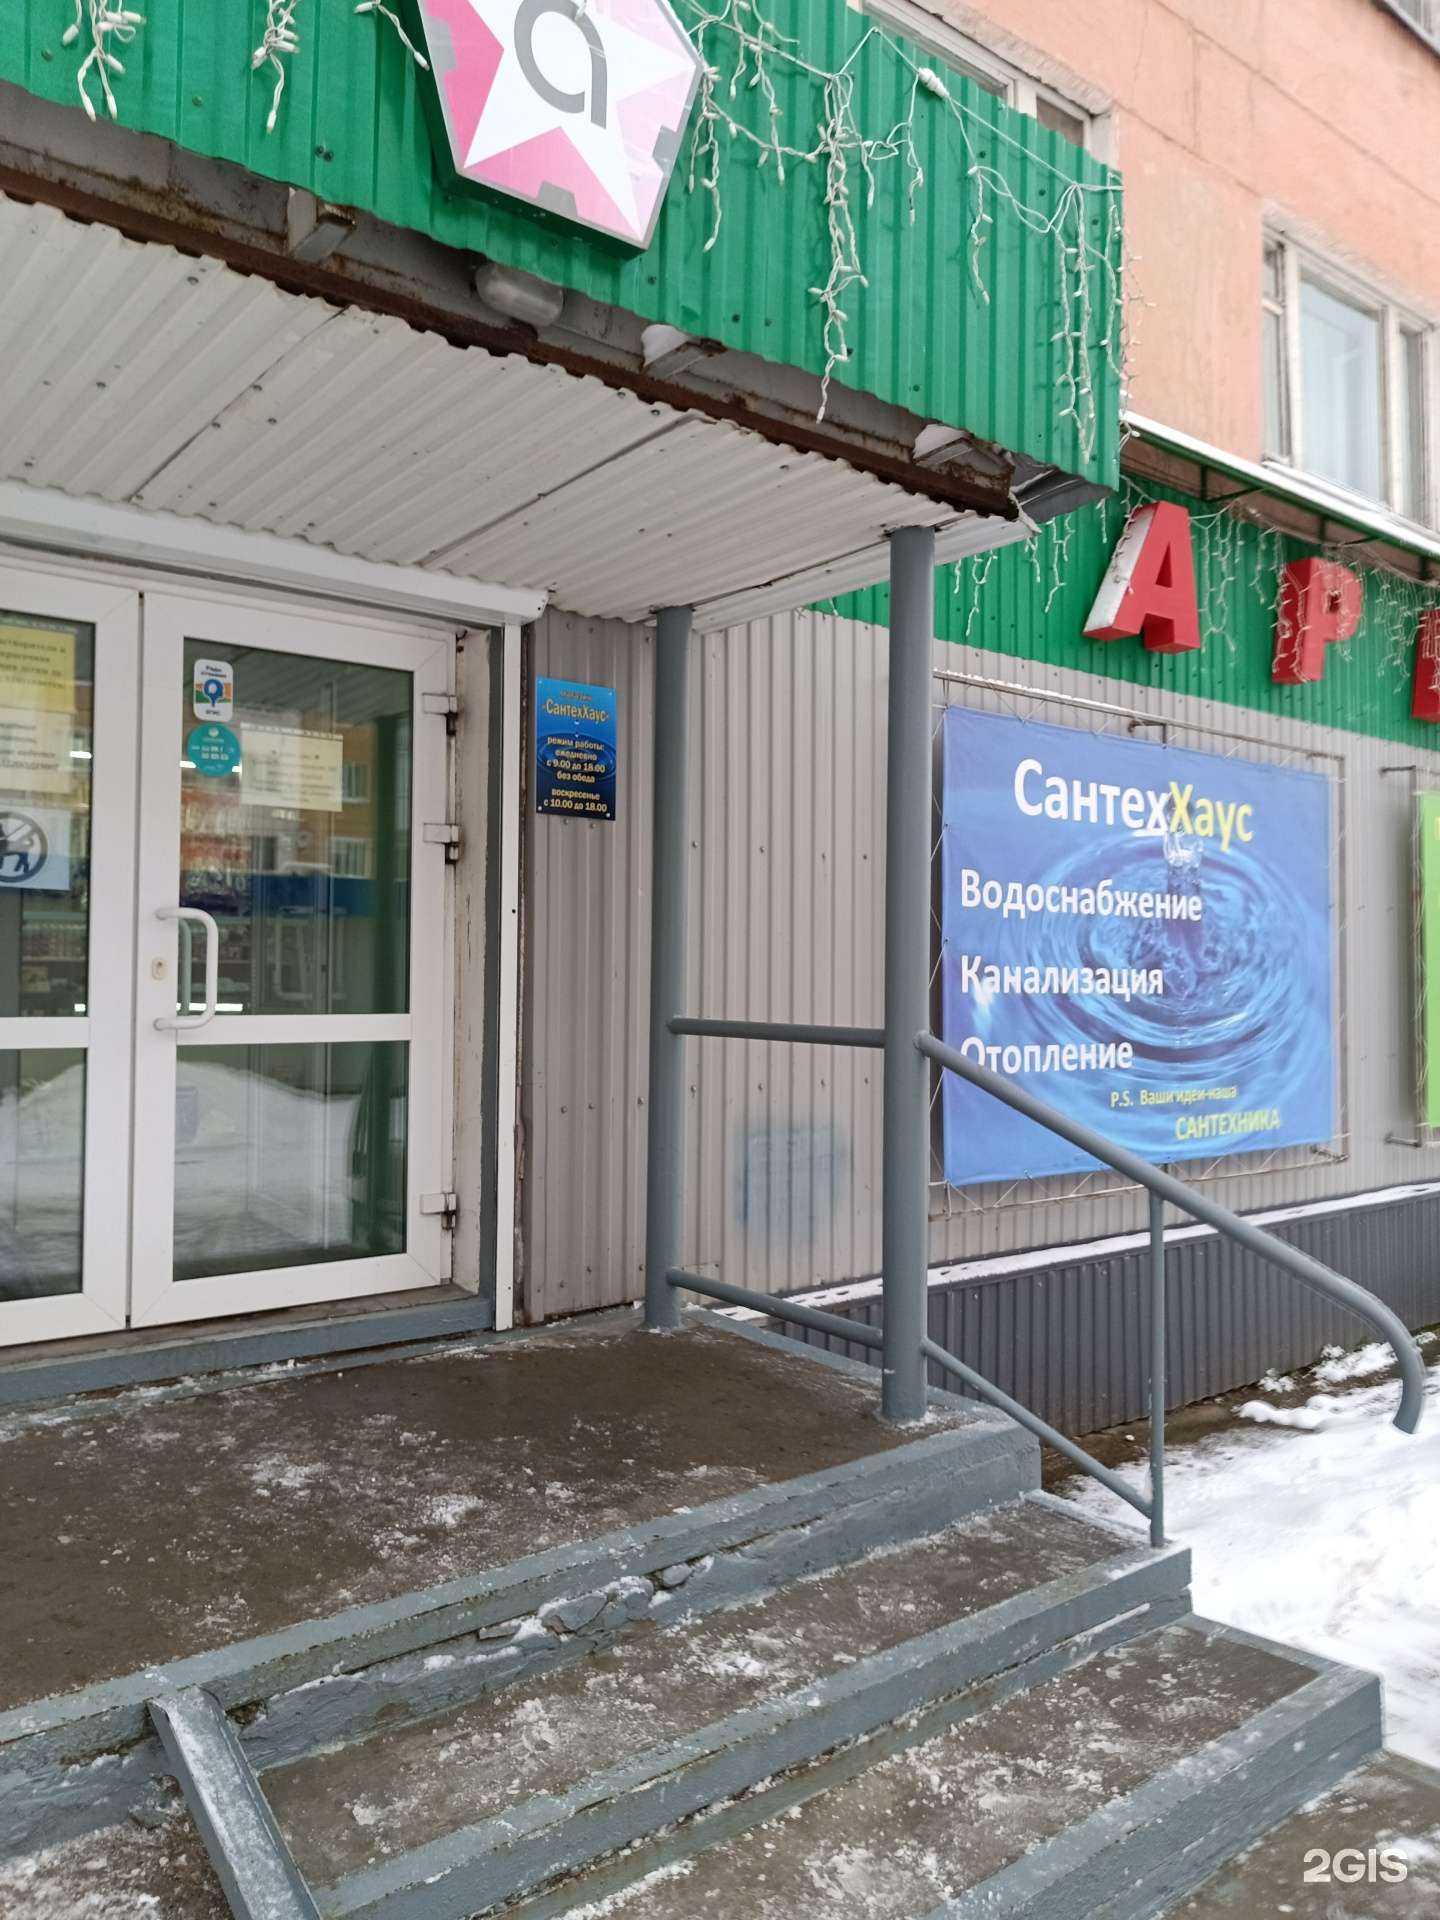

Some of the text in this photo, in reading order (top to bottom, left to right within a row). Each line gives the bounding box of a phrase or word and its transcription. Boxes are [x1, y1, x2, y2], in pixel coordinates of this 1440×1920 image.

[553, 759, 571, 769] 9.00
[583, 762, 606, 773] 18.00
[556, 770, 596, 784] без обеда
[550, 798, 573, 809] 10.00
[585, 802, 608, 813] 18.00
[551, 788, 601, 801] воскресенье
[1014, 758, 1255, 851] СантехХаус
[961, 867, 1203, 922] Водоснабжение
[960, 955, 1164, 1002] Канализация
[960, 1036, 1134, 1074] Отопление
[1110, 1090, 1134, 1108] P.S.
[1140, 1089, 1174, 1105] Ваши
[1174, 1108, 1281, 1141] САНТЕХНИКА
